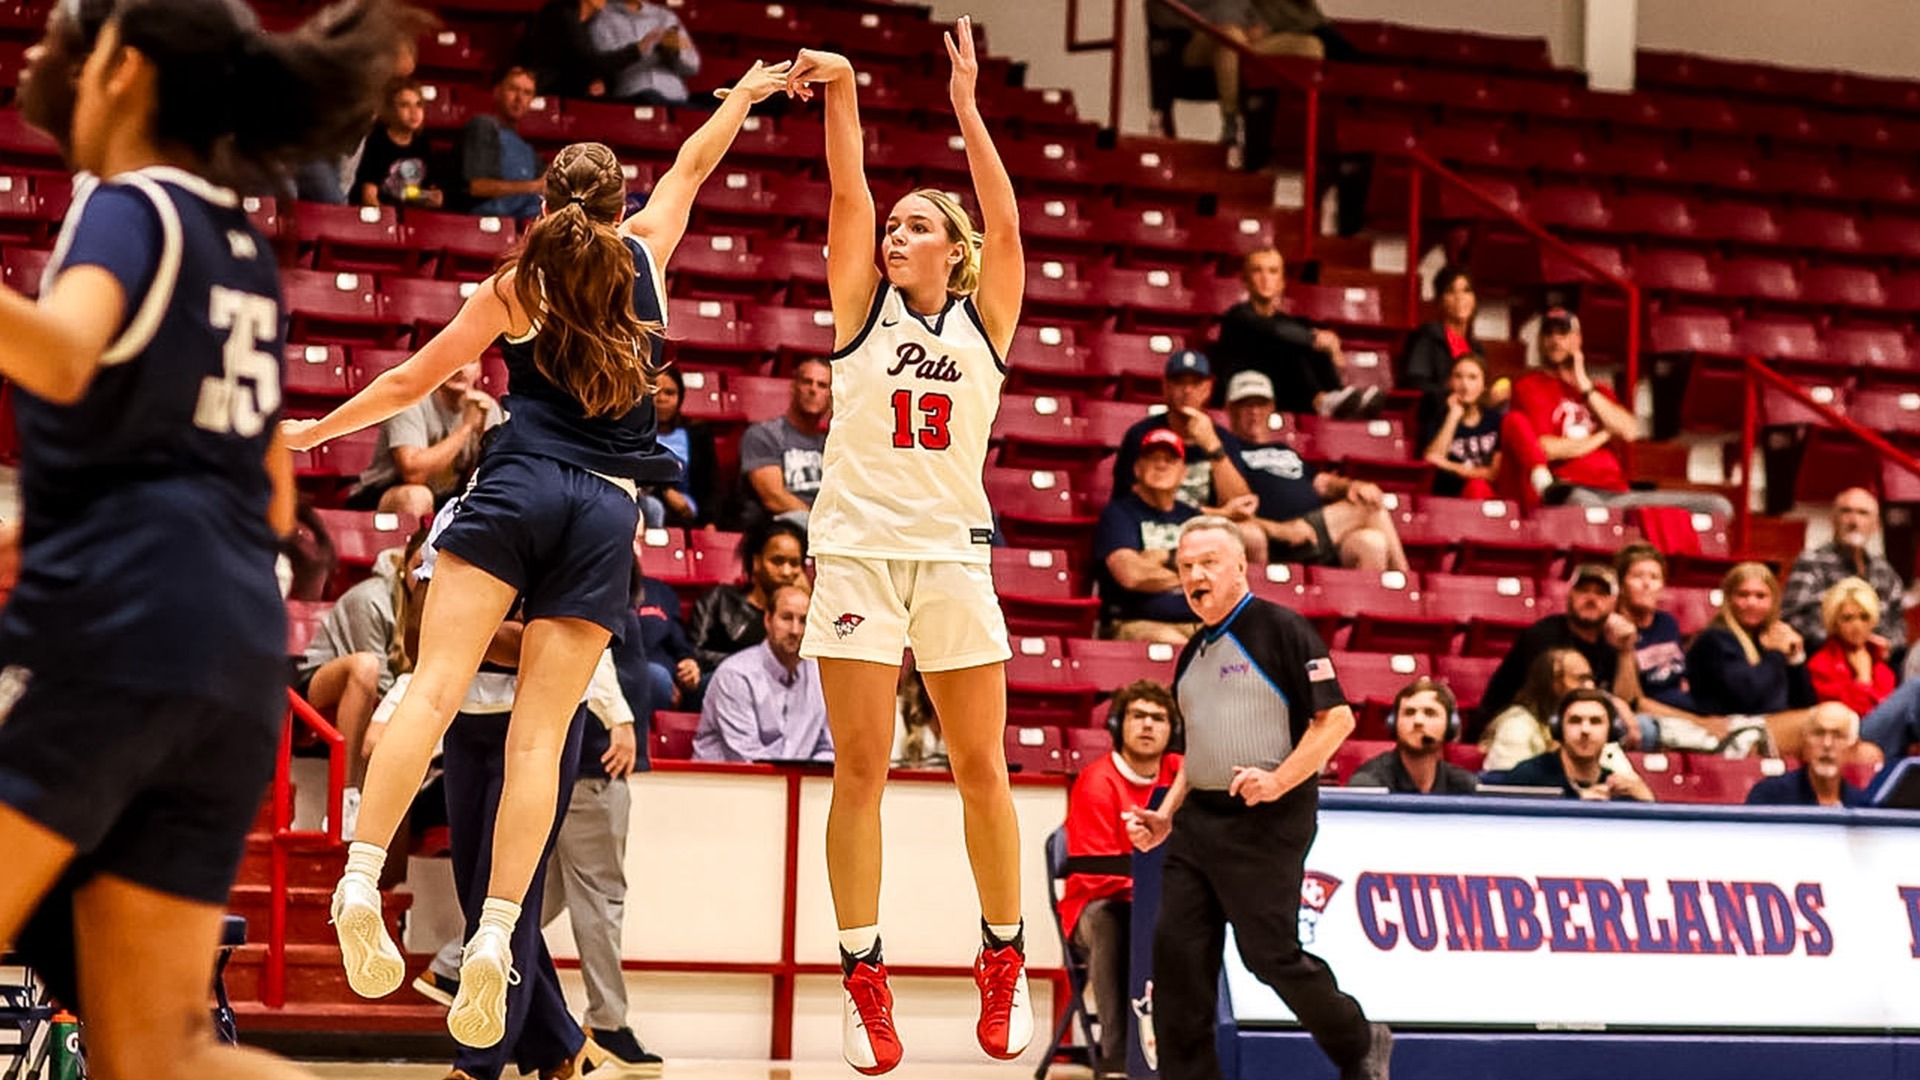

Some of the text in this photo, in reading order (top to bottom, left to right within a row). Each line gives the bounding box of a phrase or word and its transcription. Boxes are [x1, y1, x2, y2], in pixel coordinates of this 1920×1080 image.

[887, 342, 962, 382] Pats
[891, 389, 953, 450] 13
[1356, 871, 1834, 957] CUMBERLANDS
